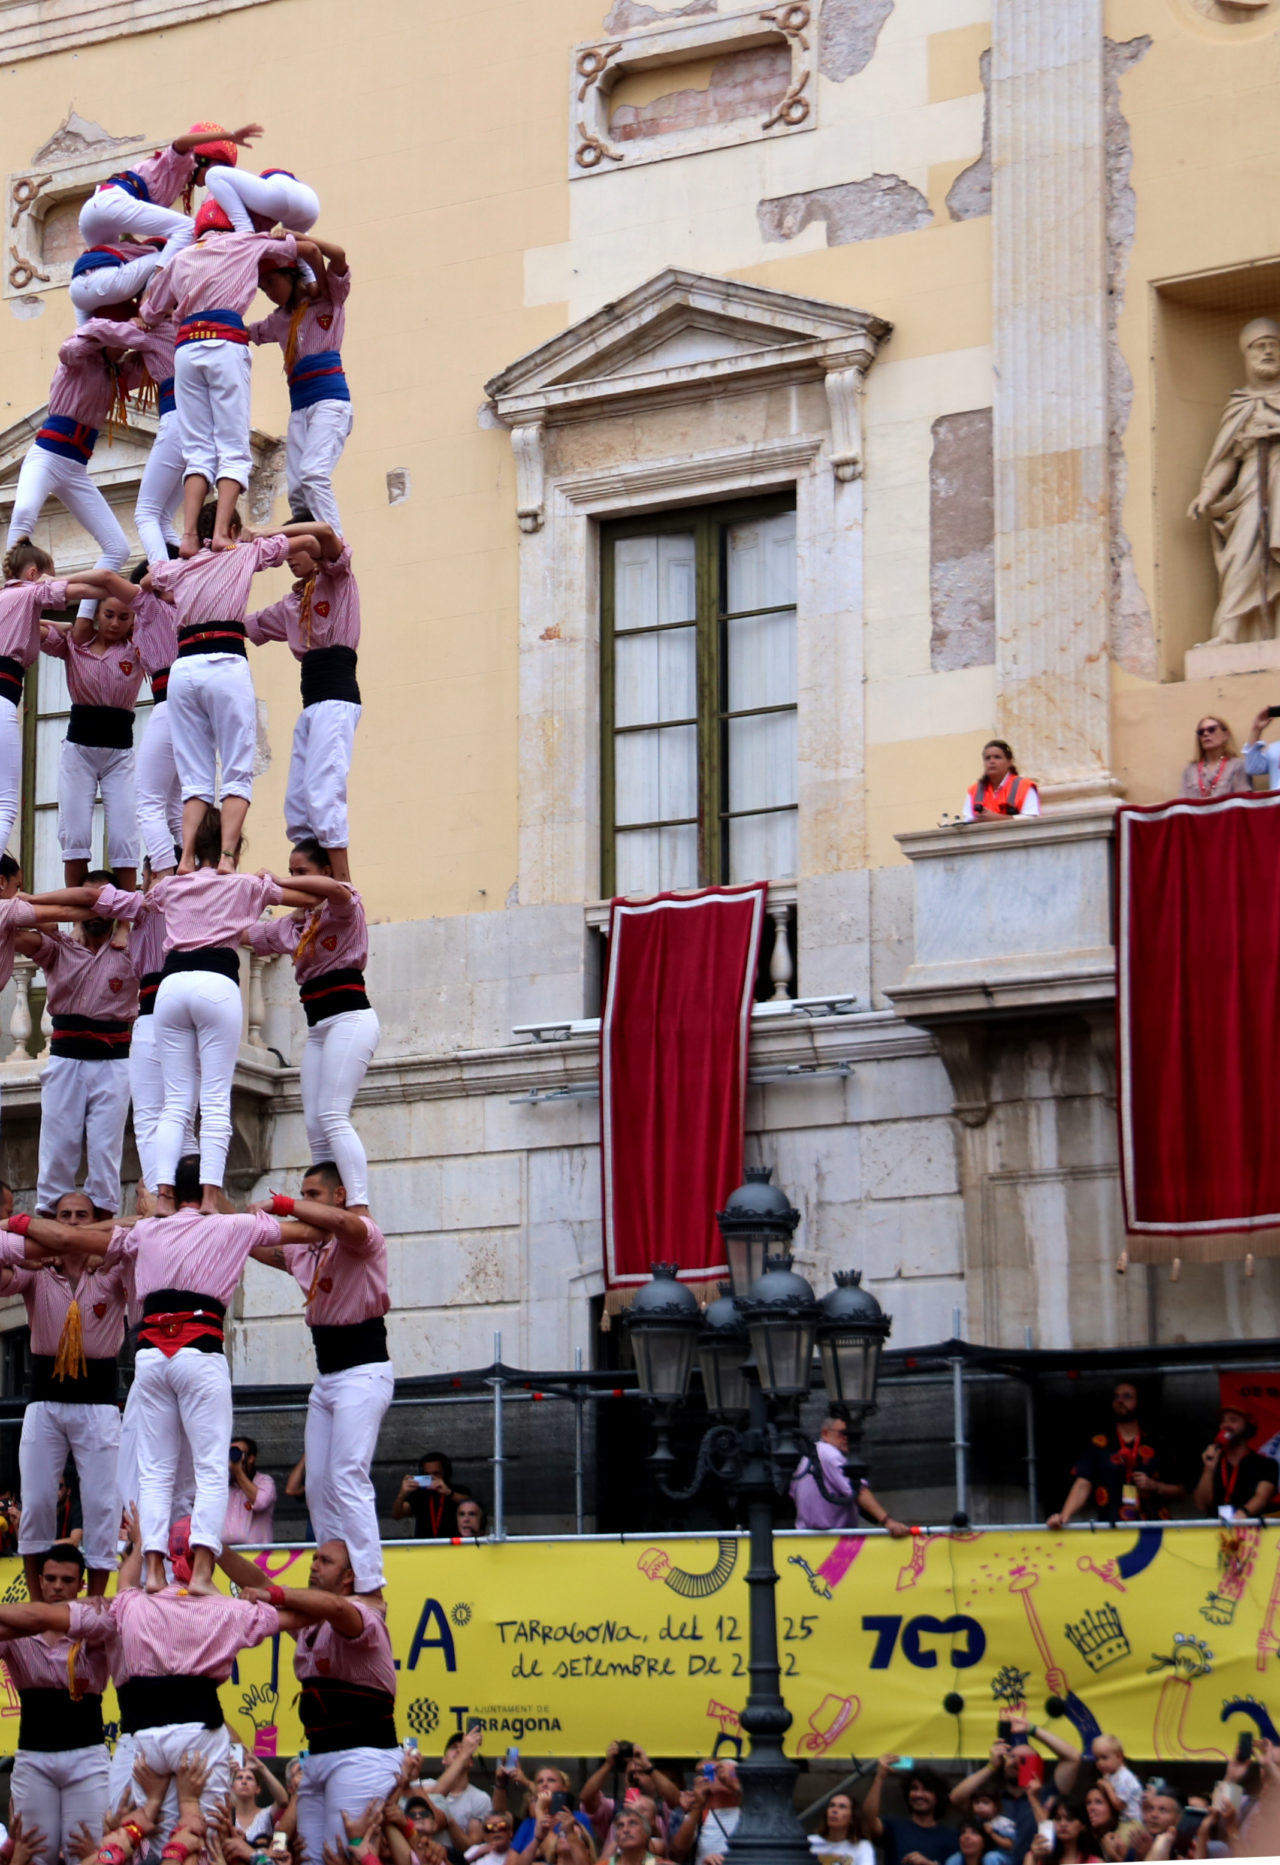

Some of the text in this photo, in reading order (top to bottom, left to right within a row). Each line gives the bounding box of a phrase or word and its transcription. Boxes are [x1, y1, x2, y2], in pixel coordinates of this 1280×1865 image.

[716, 1615, 742, 1641] 12
[783, 1615, 819, 1641] 25
[731, 1652, 800, 1677] 22
[474, 1704, 550, 1713] AJUNTAMENT DE
